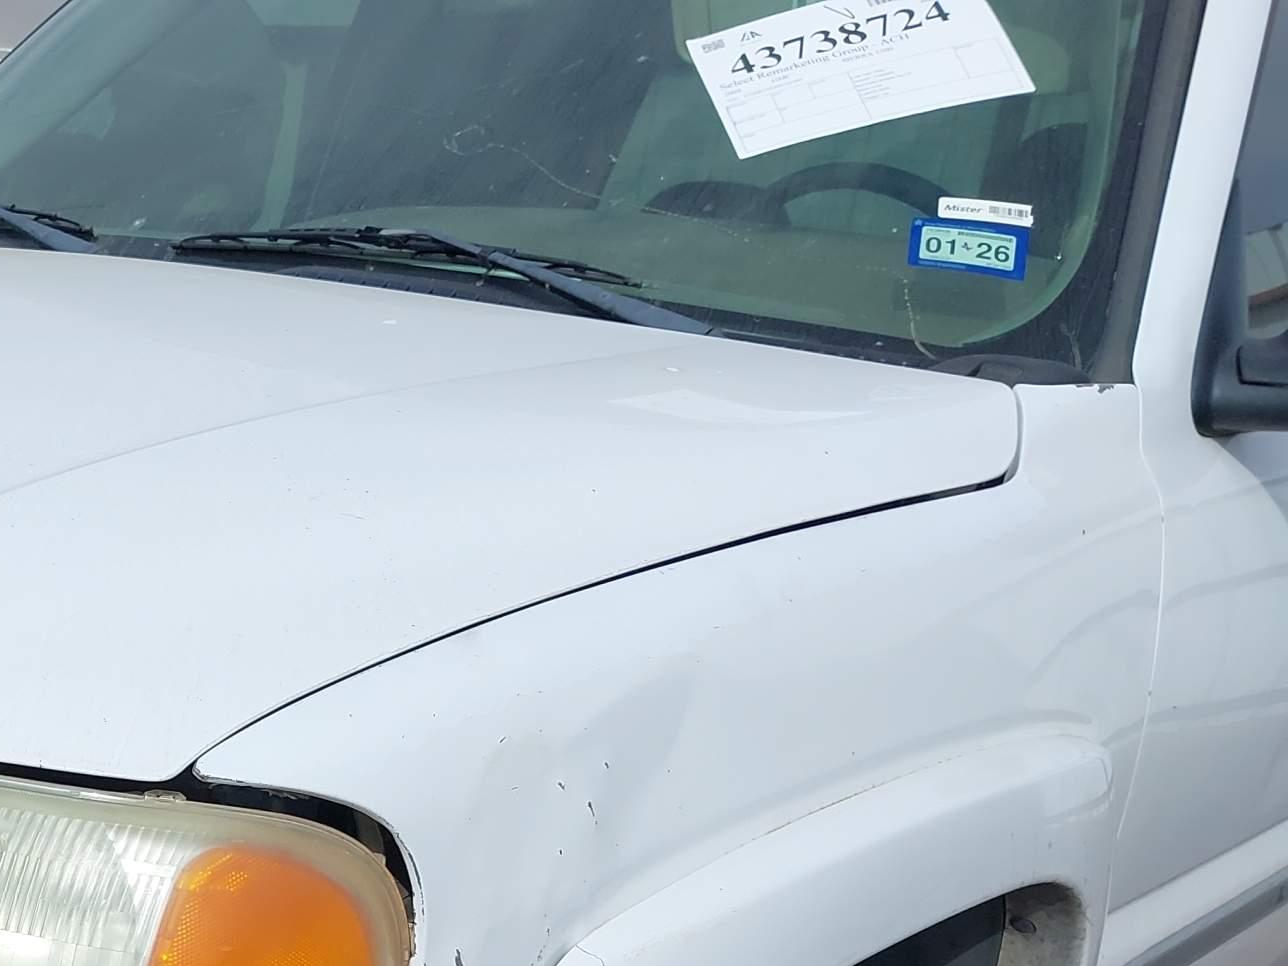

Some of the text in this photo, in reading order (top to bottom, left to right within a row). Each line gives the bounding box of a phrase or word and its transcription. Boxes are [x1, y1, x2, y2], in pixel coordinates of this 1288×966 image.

[730, 1, 950, 75] 43738724
[719, 74, 755, 89] Select
[756, 55, 830, 80] Remarketing
[831, 44, 870, 59] Group
[944, 204, 983, 214] Mister
[926, 236, 1011, 263] 01 26
